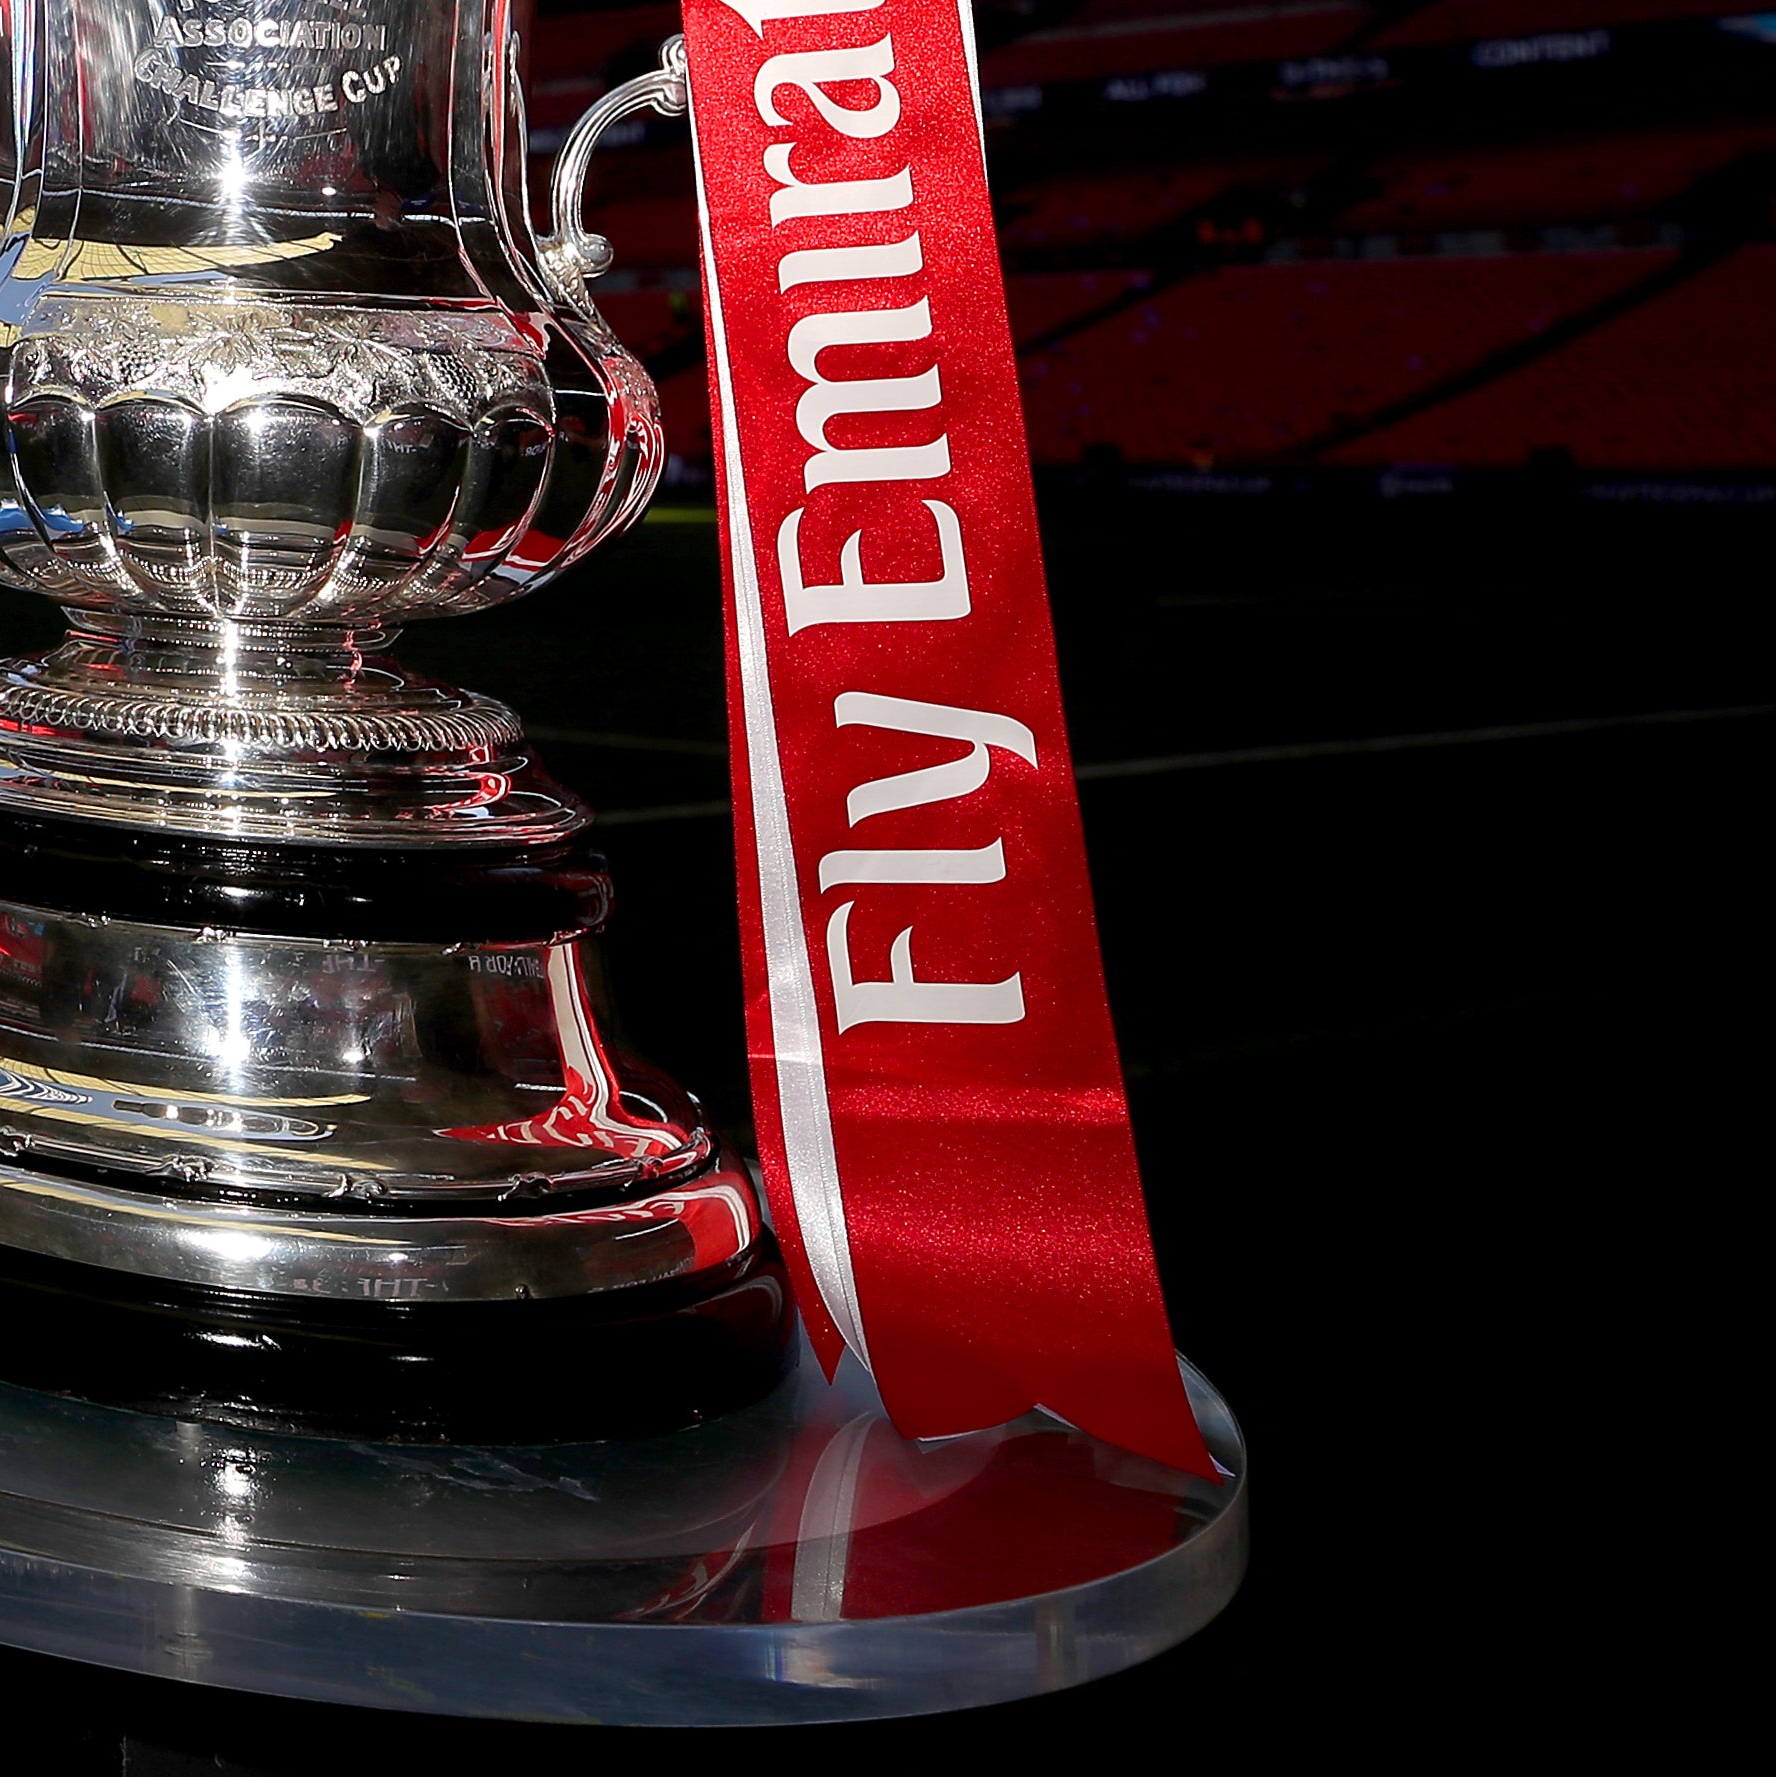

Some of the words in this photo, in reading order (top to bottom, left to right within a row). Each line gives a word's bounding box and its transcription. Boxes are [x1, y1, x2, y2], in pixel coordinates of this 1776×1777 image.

[153, 14, 388, 52] ASSOCIATION
[133, 46, 340, 118] CHALLENGE
[339, 54, 404, 105] CUP
[818, 691, 1039, 1036] Fly
